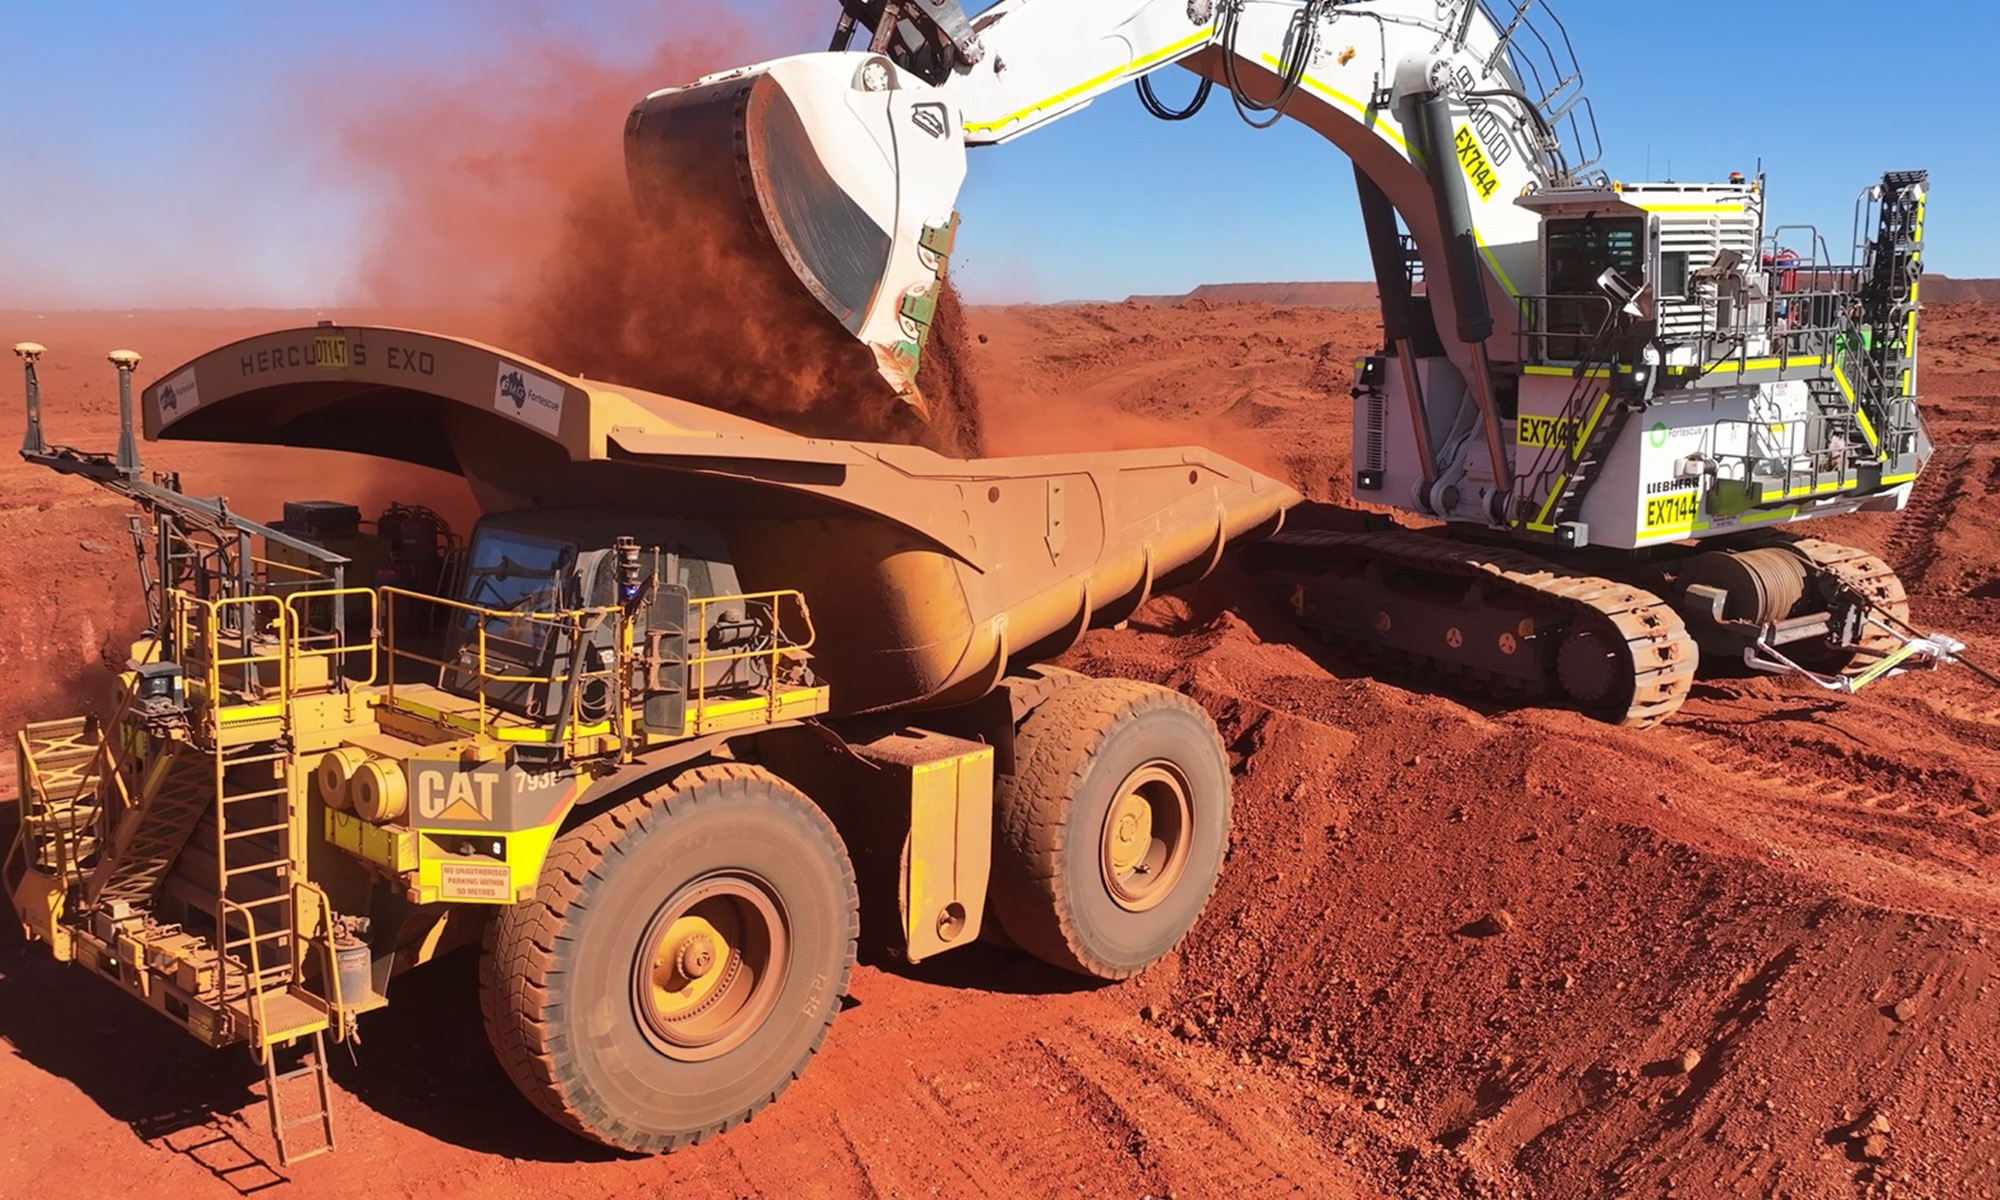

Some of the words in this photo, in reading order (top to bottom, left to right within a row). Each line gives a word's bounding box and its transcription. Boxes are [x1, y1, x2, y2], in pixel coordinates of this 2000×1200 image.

[1455, 127, 1497, 197] EX7144
[241, 344, 366, 376] HERCUS
[387, 346, 434, 376] EXO
[315, 339, 346, 364] DT147
[528, 389, 561, 412] Fortescue
[1646, 477, 1700, 494] LIEBHERR
[1646, 495, 1697, 526] EX7144
[418, 770, 499, 821] CAT
[443, 866, 454, 874] NO
[447, 877, 479, 885] PARKING
[456, 887, 466, 895] 50
[467, 888, 496, 896] METRES
